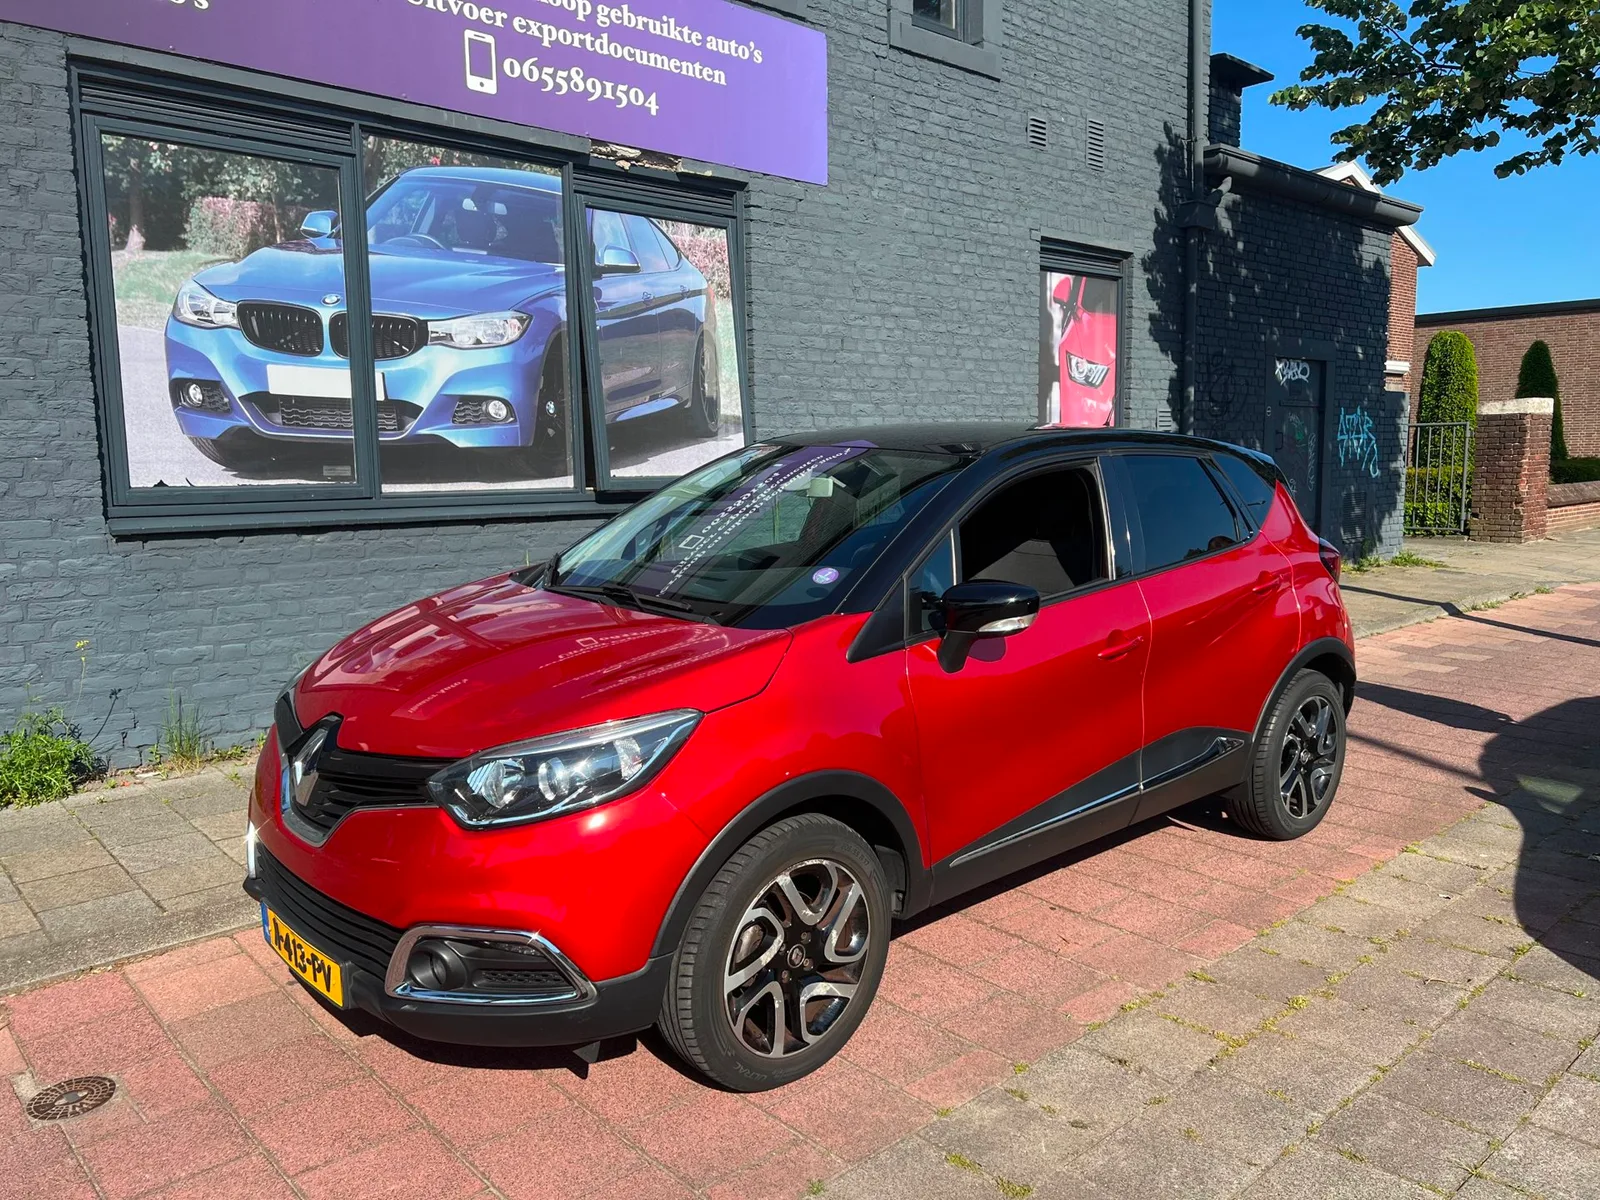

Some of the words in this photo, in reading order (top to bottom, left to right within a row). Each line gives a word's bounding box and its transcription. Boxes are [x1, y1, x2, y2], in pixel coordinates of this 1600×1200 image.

[407, 0, 508, 28] tvoer
[512, 16, 727, 86] exportdocumenten
[537, 0, 592, 22] op
[596, 4, 703, 46] gebruikte
[706, 35, 764, 64] auto's
[503, 57, 660, 116] 0655891504
